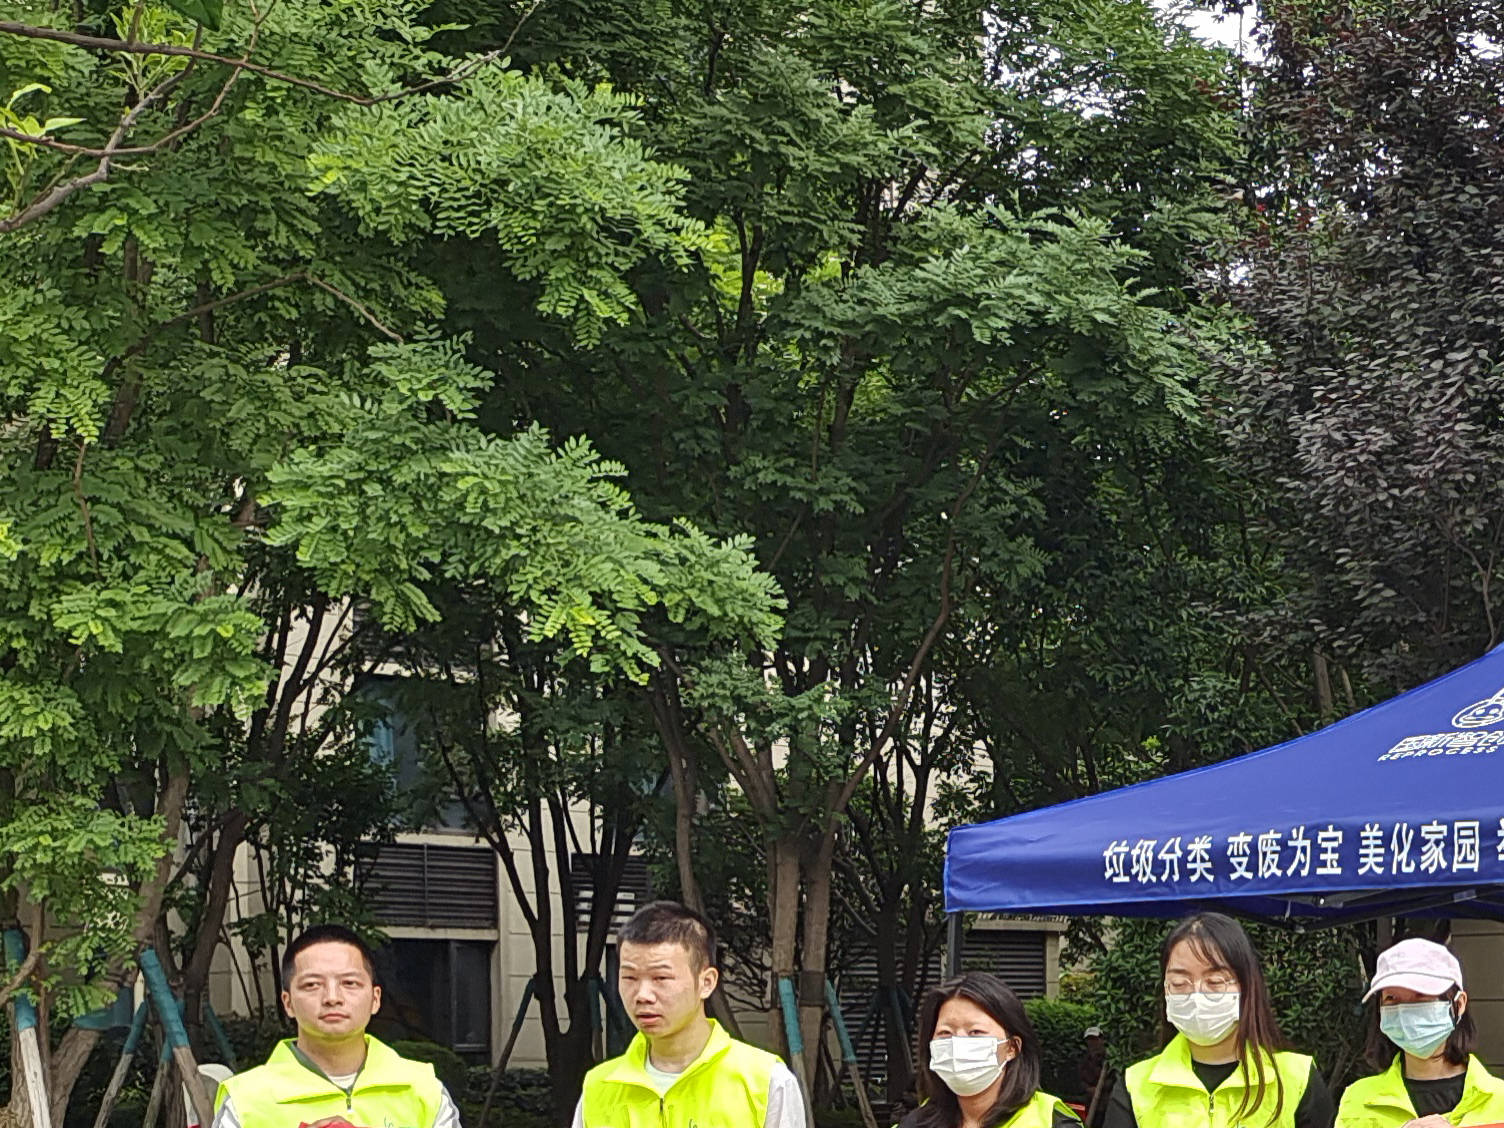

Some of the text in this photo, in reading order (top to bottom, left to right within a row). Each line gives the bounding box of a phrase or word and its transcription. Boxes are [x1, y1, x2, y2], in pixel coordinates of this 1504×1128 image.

[1102, 836, 1214, 884] 垃圾分类
[1226, 825, 1343, 881] 变废为宝
[1357, 820, 1480, 875] 美化家园
